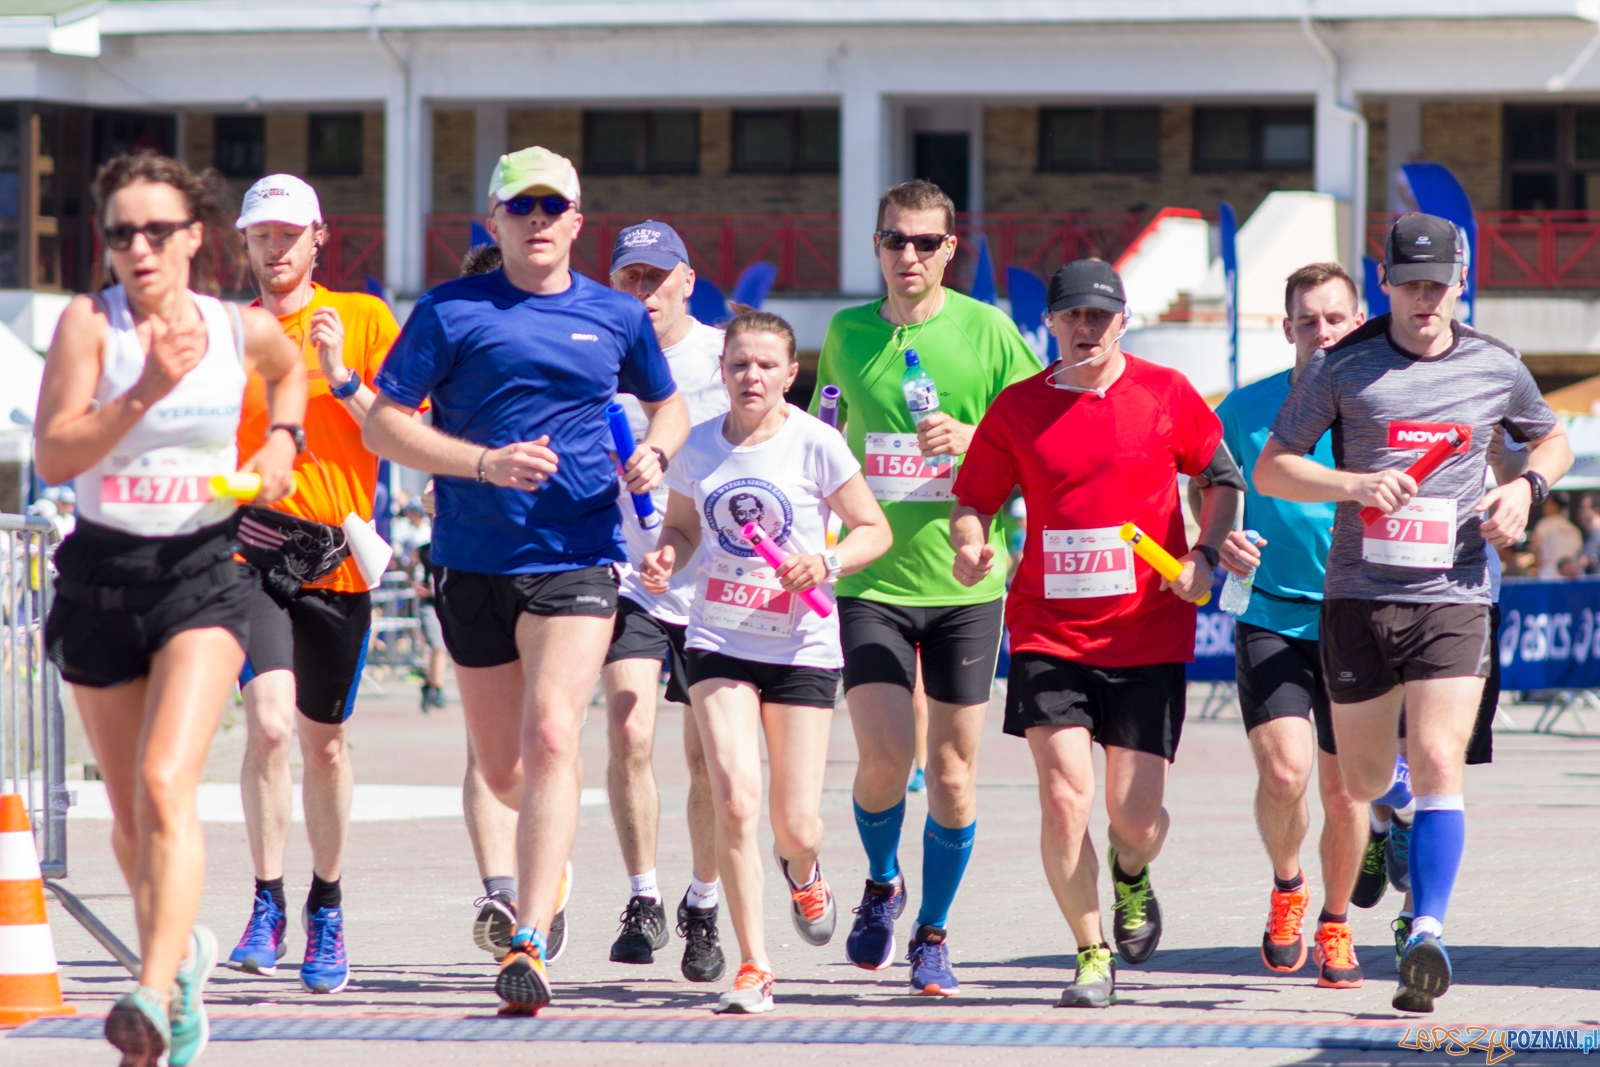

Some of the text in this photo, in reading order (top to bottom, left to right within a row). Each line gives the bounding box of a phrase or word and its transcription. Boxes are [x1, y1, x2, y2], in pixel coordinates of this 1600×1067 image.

[624, 228, 662, 241] ATHLETIC
[117, 476, 198, 502] 147/1
[1386, 519, 1423, 541] 9/1
[1053, 550, 1114, 573] 157/1
[721, 582, 771, 608] 56/1
